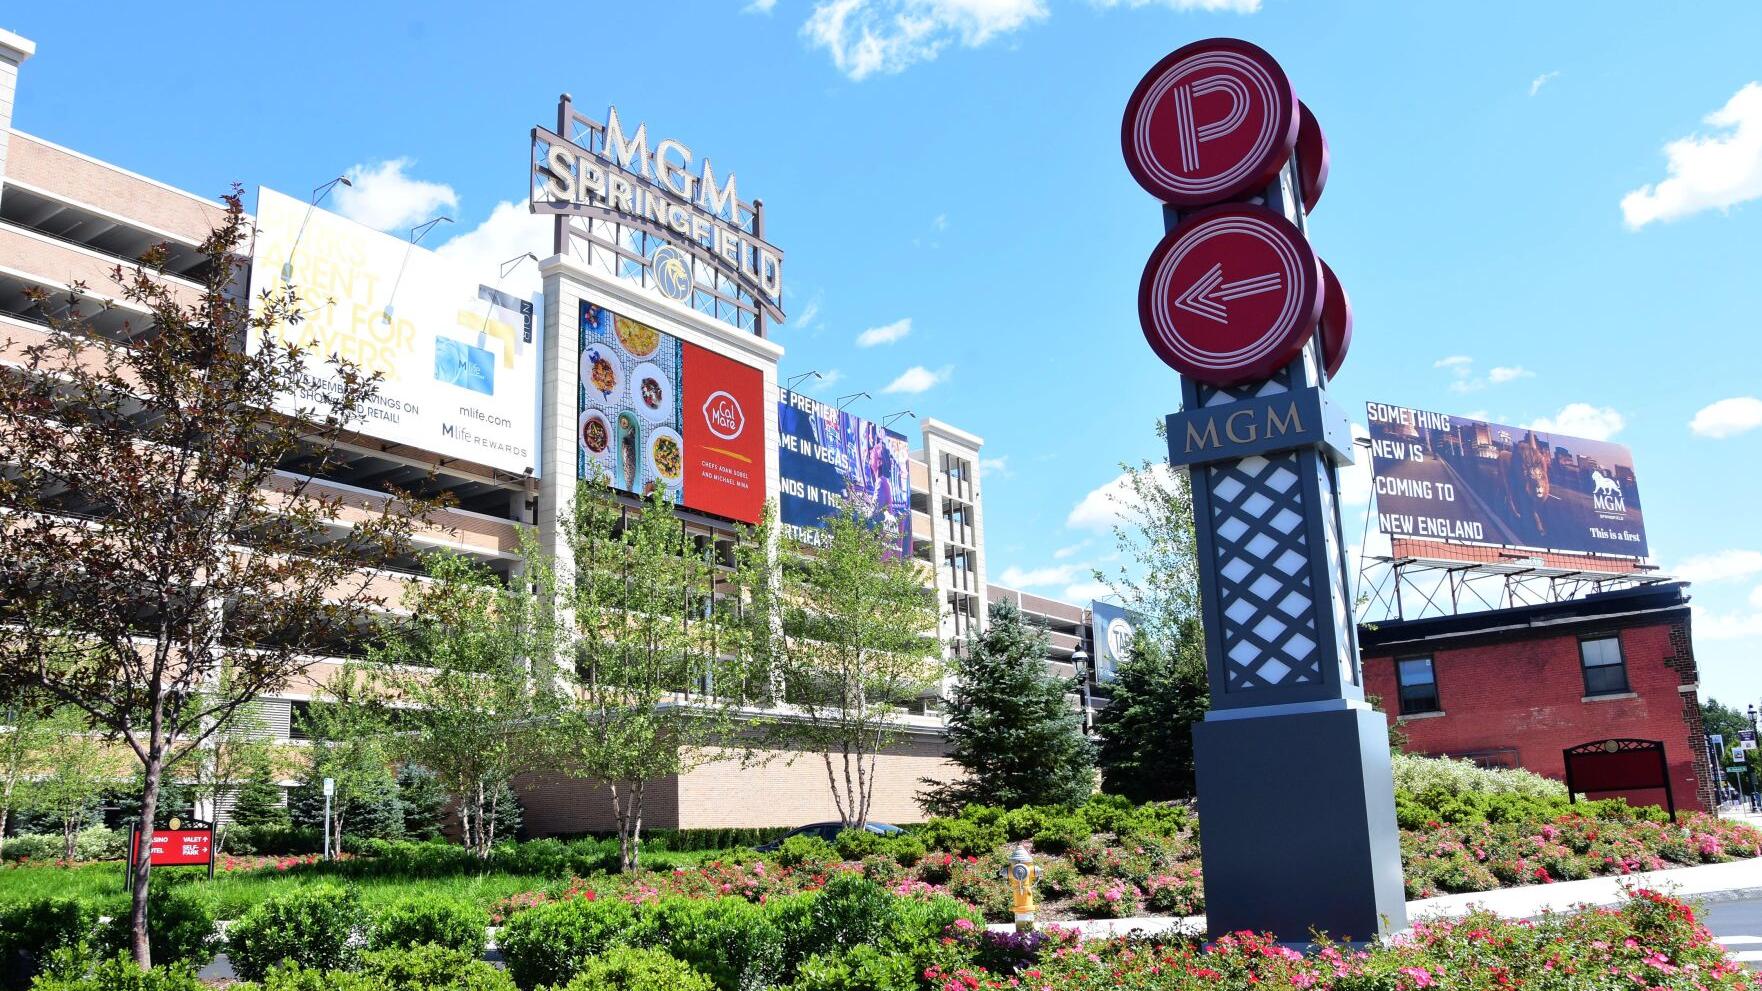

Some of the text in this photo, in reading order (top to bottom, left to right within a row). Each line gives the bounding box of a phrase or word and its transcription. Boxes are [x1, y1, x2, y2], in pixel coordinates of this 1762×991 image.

[1173, 73, 1251, 174] P
[601, 103, 741, 227] MGM
[546, 144, 782, 299] SPRINGFIELD
[352, 303, 416, 352] FOR
[367, 406, 400, 423] RETAIL!
[403, 402, 419, 416] ON
[459, 406, 512, 429] mlife.com
[719, 401, 735, 420] Cal
[790, 391, 839, 422] PREMIER
[1367, 402, 1451, 432] SOMETHING
[712, 407, 736, 430] Mare
[1184, 400, 1307, 454] MGM
[474, 436, 528, 458] REWARDS
[800, 438, 812, 457] IN
[1371, 438, 1424, 463] NEW IS
[701, 460, 748, 479] CHEFS ADAM SOBEL
[702, 470, 749, 489] AND MICHAEL MINA
[807, 484, 819, 503] IN
[1375, 475, 1455, 502] COMING TO
[1593, 493, 1626, 513] MGM
[1379, 513, 1484, 540] NEW ENGLAND
[1590, 527, 1641, 542] This is a first
